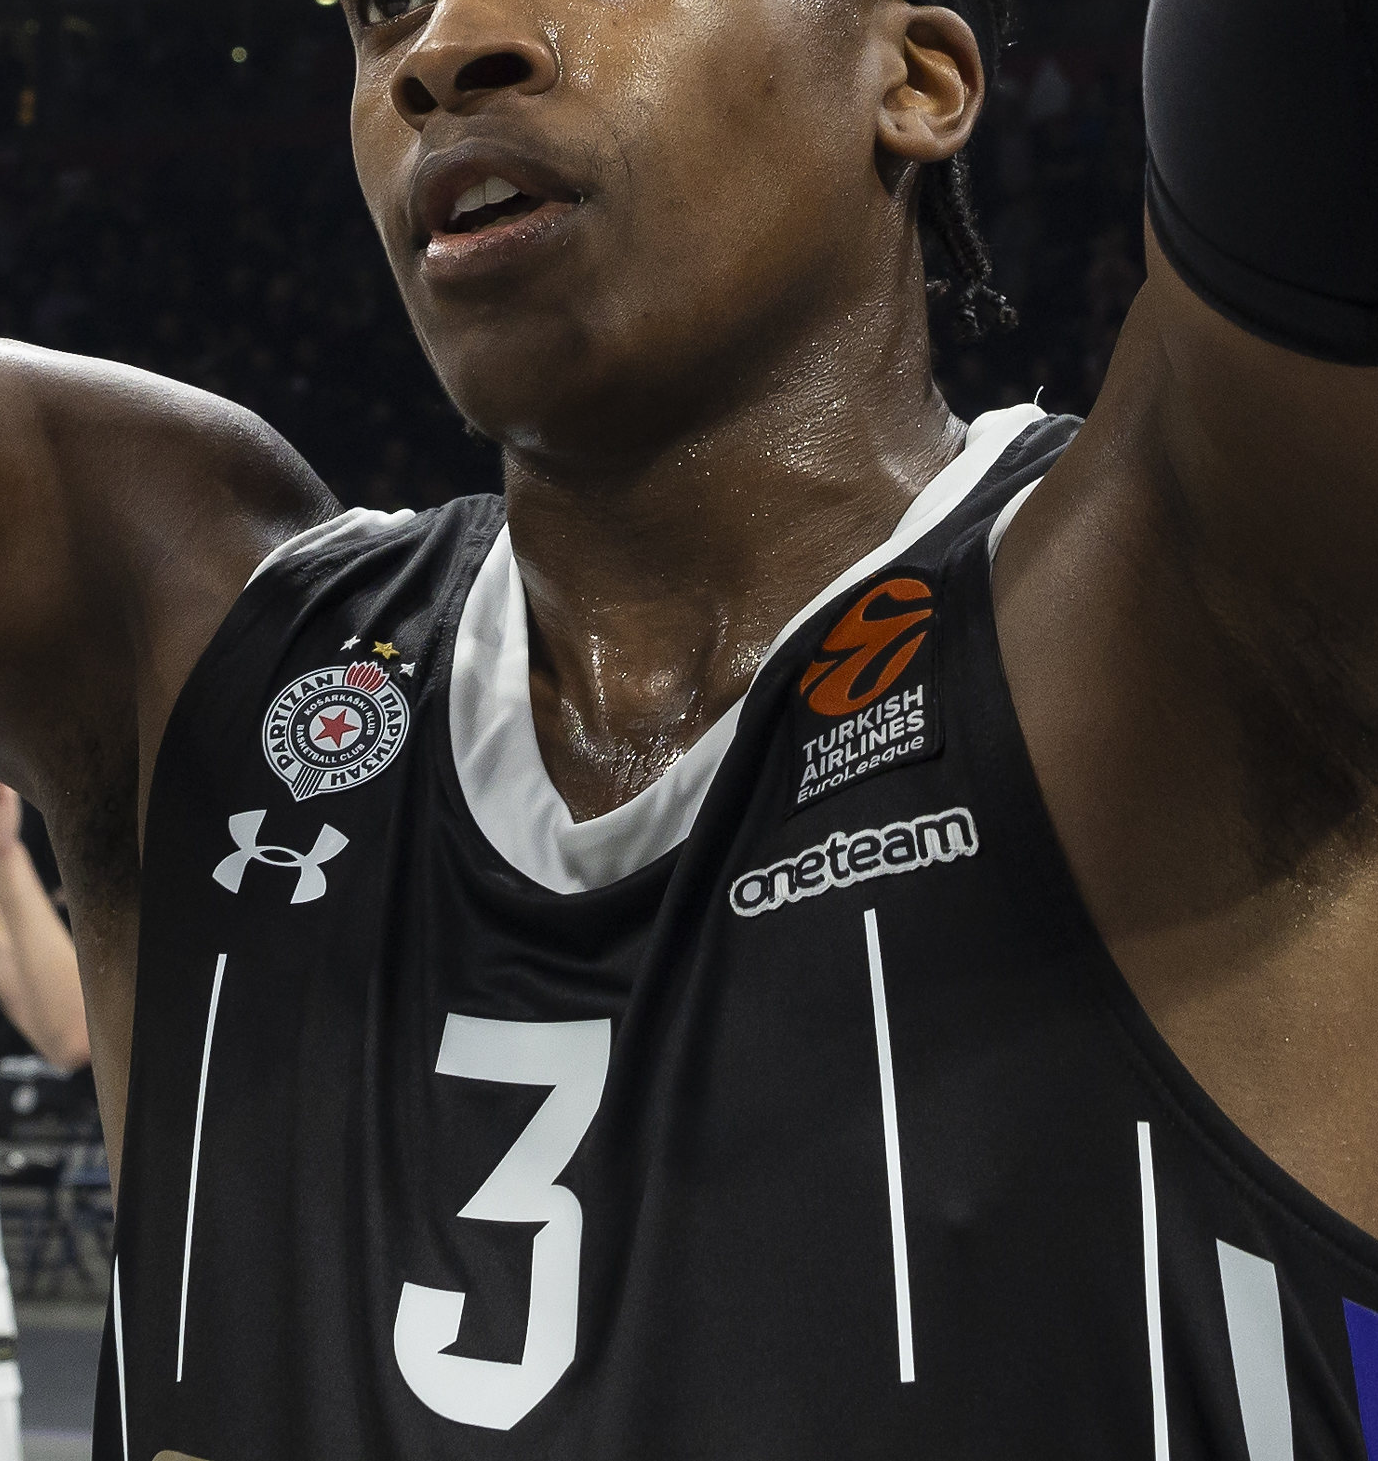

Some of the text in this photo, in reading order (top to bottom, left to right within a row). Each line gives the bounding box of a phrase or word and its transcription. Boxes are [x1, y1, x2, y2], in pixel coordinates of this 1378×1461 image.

[268, 673, 334, 772] PARTIZAN
[296, 724, 366, 764] BASKETBALL CLUB
[330, 692, 403, 786] ПАРТИЗАН
[365, 710, 376, 736] KLUB
[800, 709, 925, 788] AIRLINES
[802, 684, 924, 762] TURKISH
[797, 735, 925, 804] EuroLeague
[730, 808, 978, 914] oneteam
[393, 1012, 612, 1431] 3
